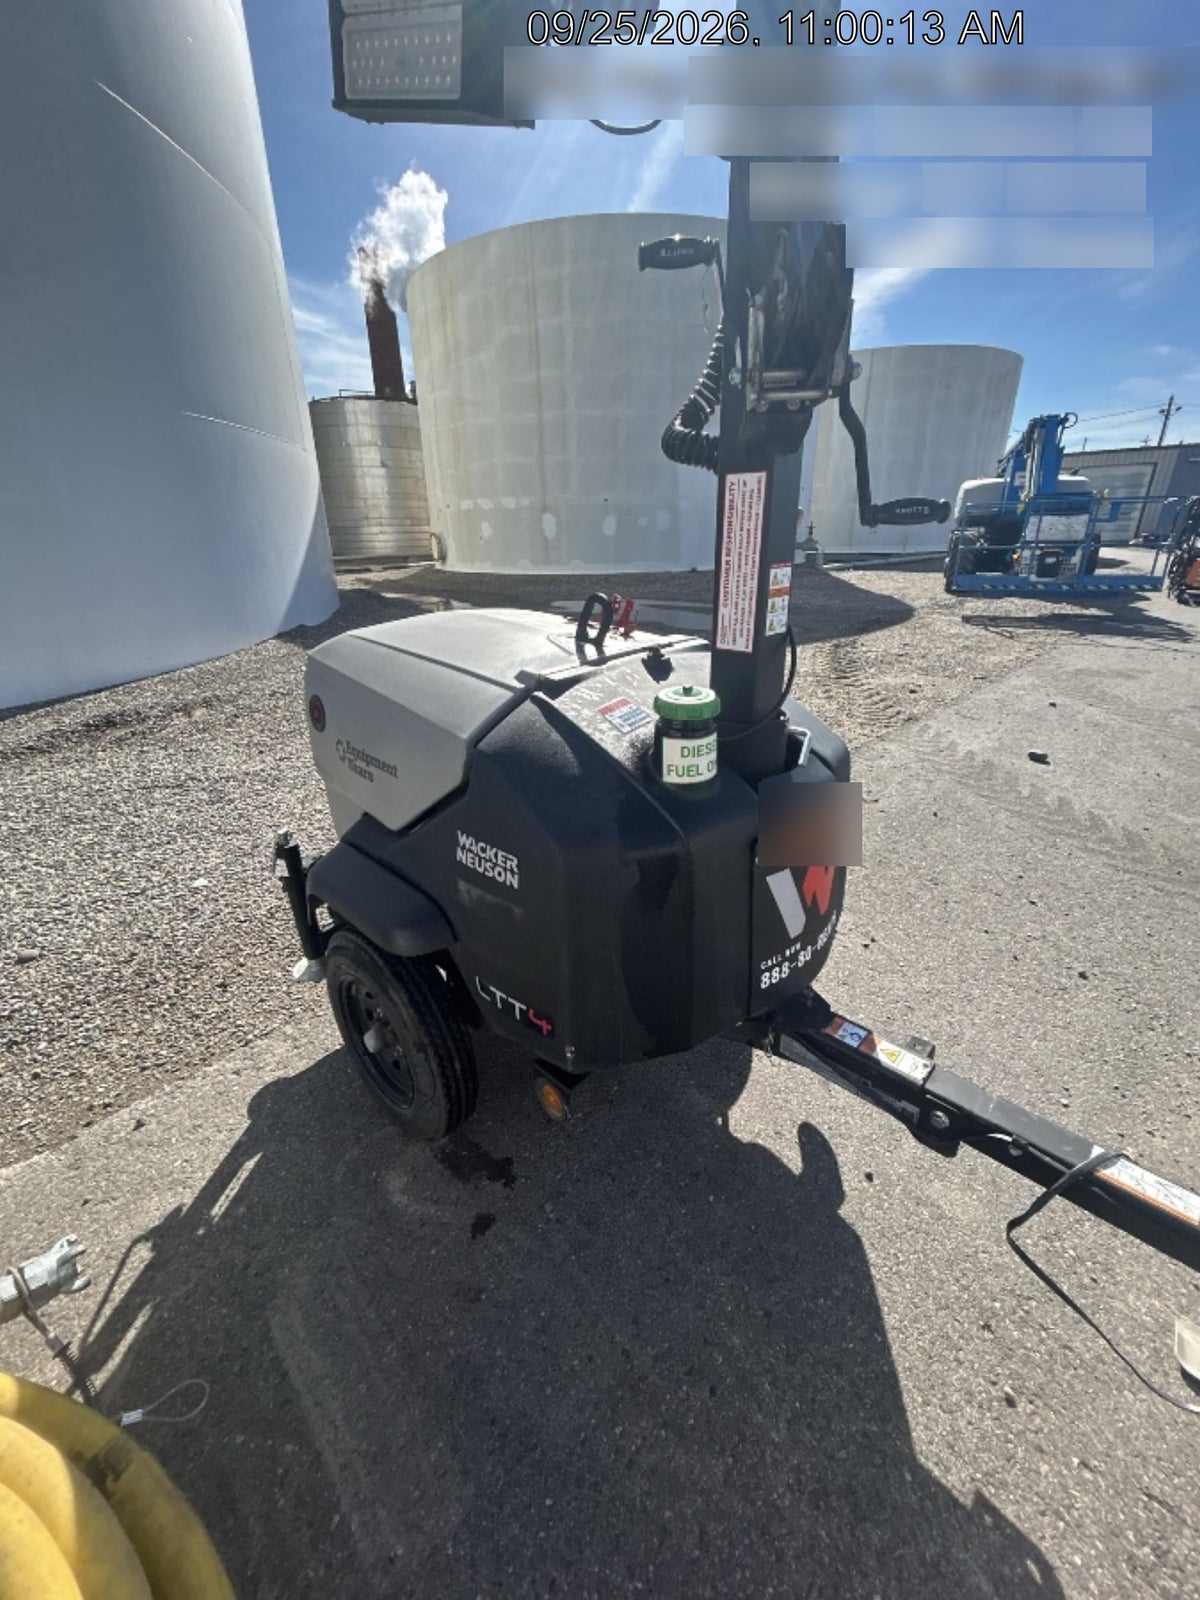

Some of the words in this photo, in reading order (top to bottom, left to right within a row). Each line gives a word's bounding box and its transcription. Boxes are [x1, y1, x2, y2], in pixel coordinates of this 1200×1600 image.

[725, 481, 736, 557] RESPONSIBILITY
[346, 740, 399, 779] Equipment
[667, 763, 704, 778] FUEL
[456, 830, 519, 873] WACKER
[456, 850, 519, 890] NEUSON
[475, 975, 552, 1036] LTT4
